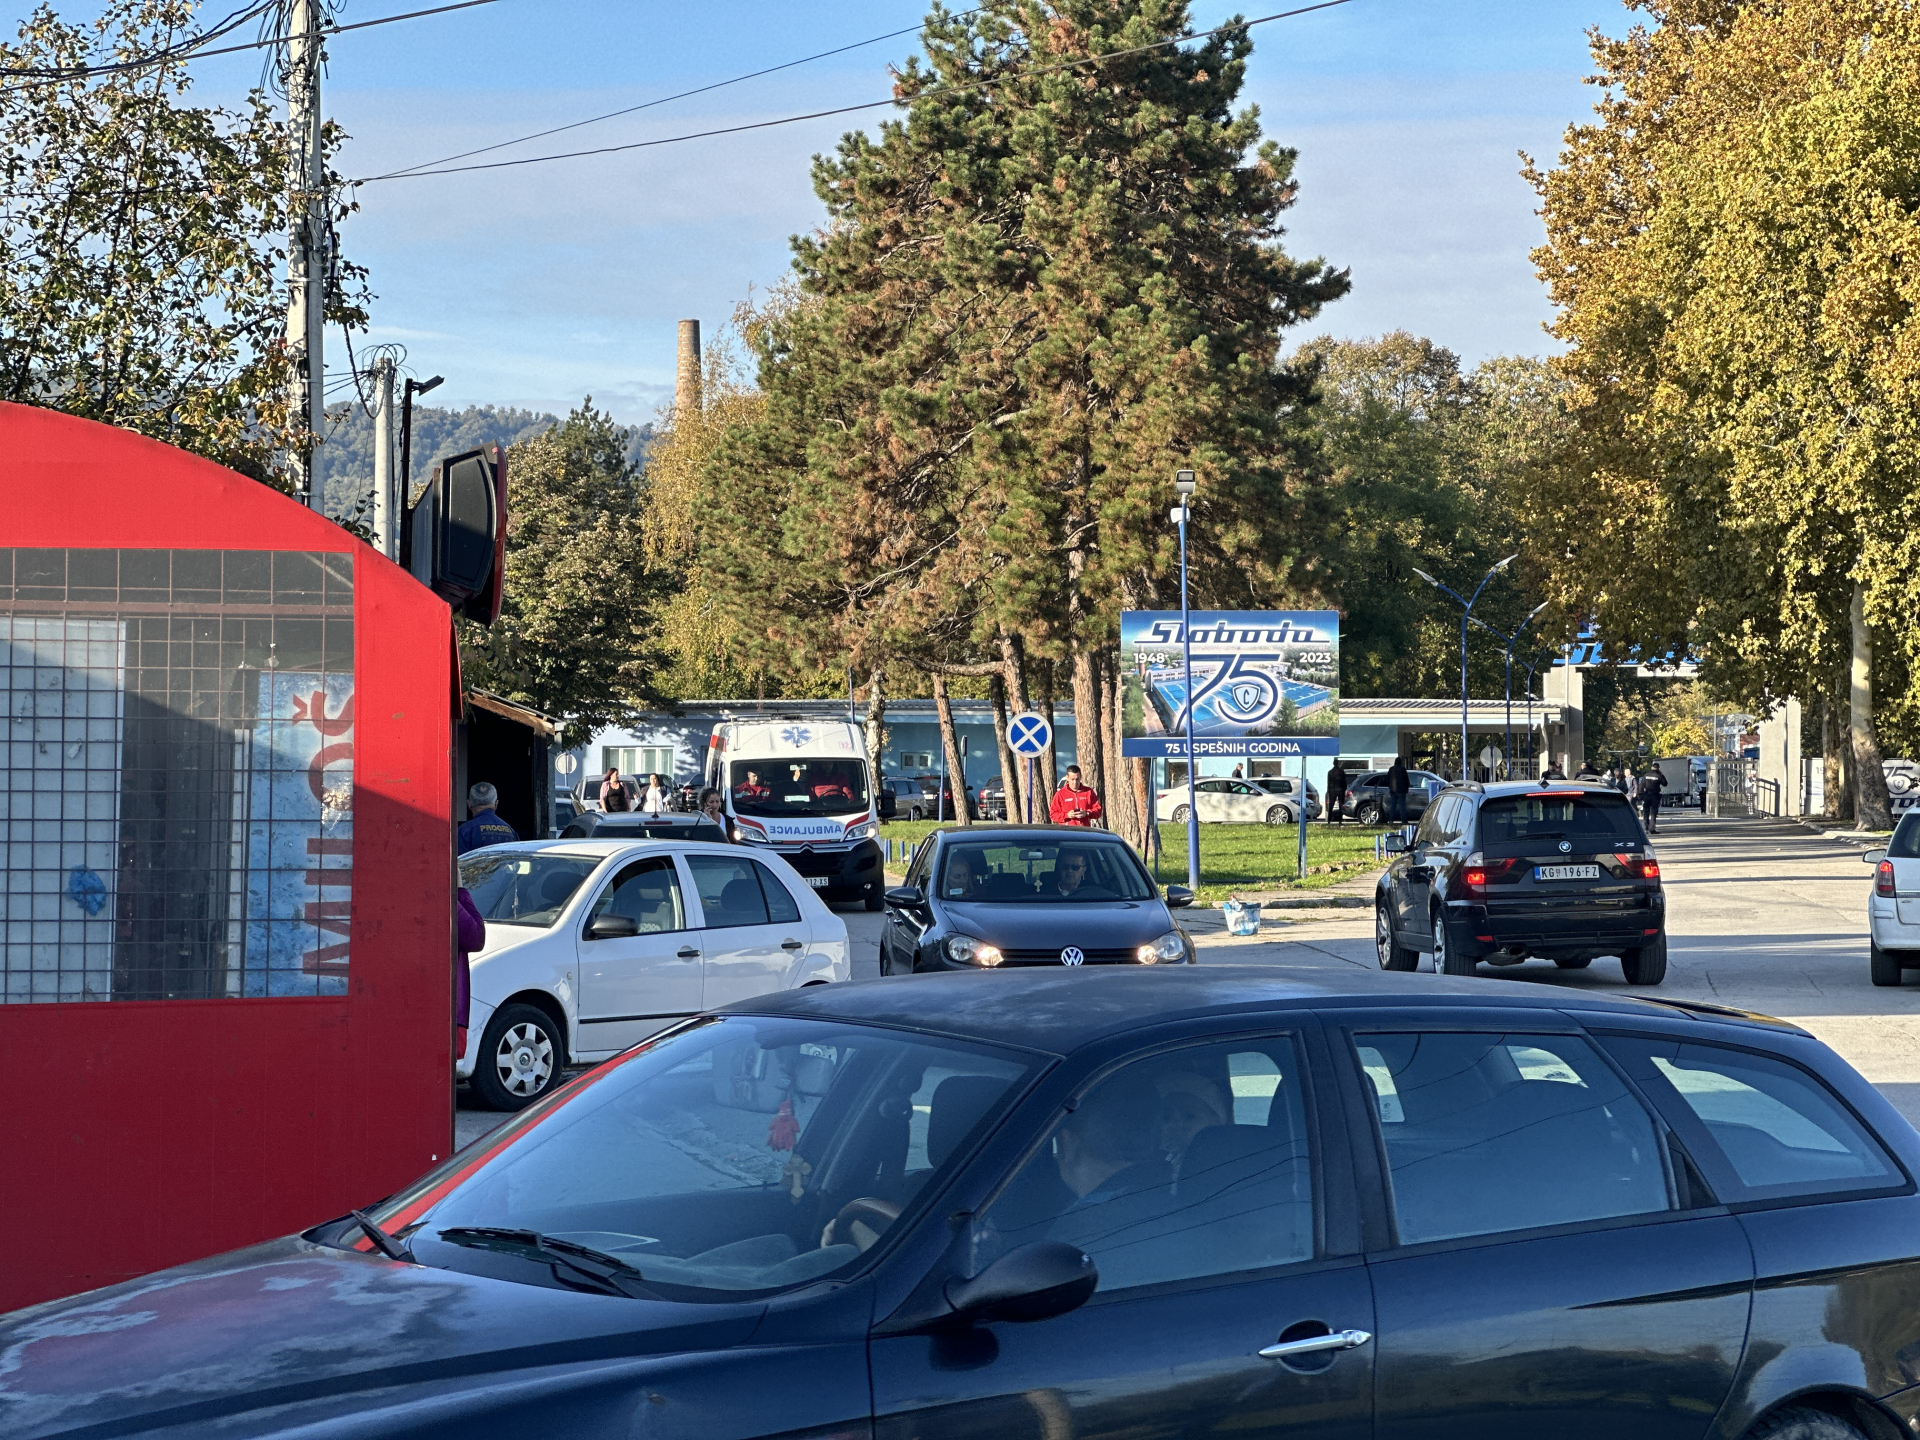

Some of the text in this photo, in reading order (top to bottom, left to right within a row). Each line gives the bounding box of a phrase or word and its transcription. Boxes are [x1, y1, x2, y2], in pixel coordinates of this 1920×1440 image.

[1133, 652, 1165, 664] 1948
[1299, 652, 1331, 663] 2023
[1175, 653, 1281, 724] 75
[1165, 743, 1181, 754] 75
[1249, 742, 1301, 753] GODINA
[1541, 867, 1555, 879] KG
